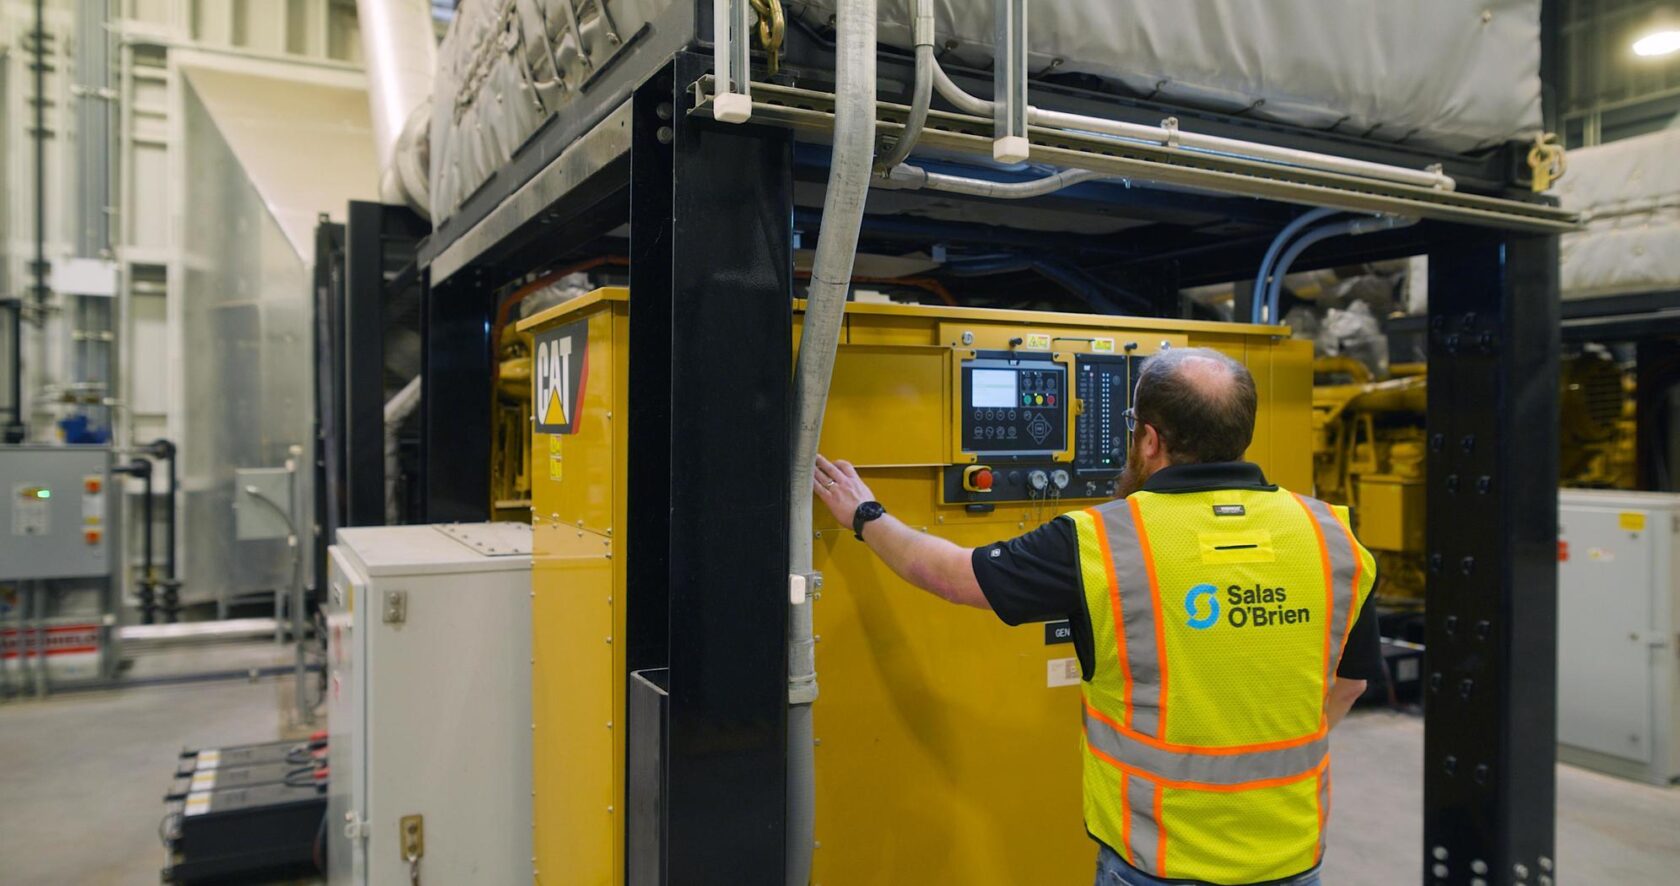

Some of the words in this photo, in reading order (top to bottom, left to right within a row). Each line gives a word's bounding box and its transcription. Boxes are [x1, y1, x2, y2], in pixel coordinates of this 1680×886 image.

[537, 335, 572, 425] CAT
[1227, 584, 1287, 605] Salas
[1228, 605, 1310, 628] O'Brien
[1055, 628, 1071, 638] GEN
